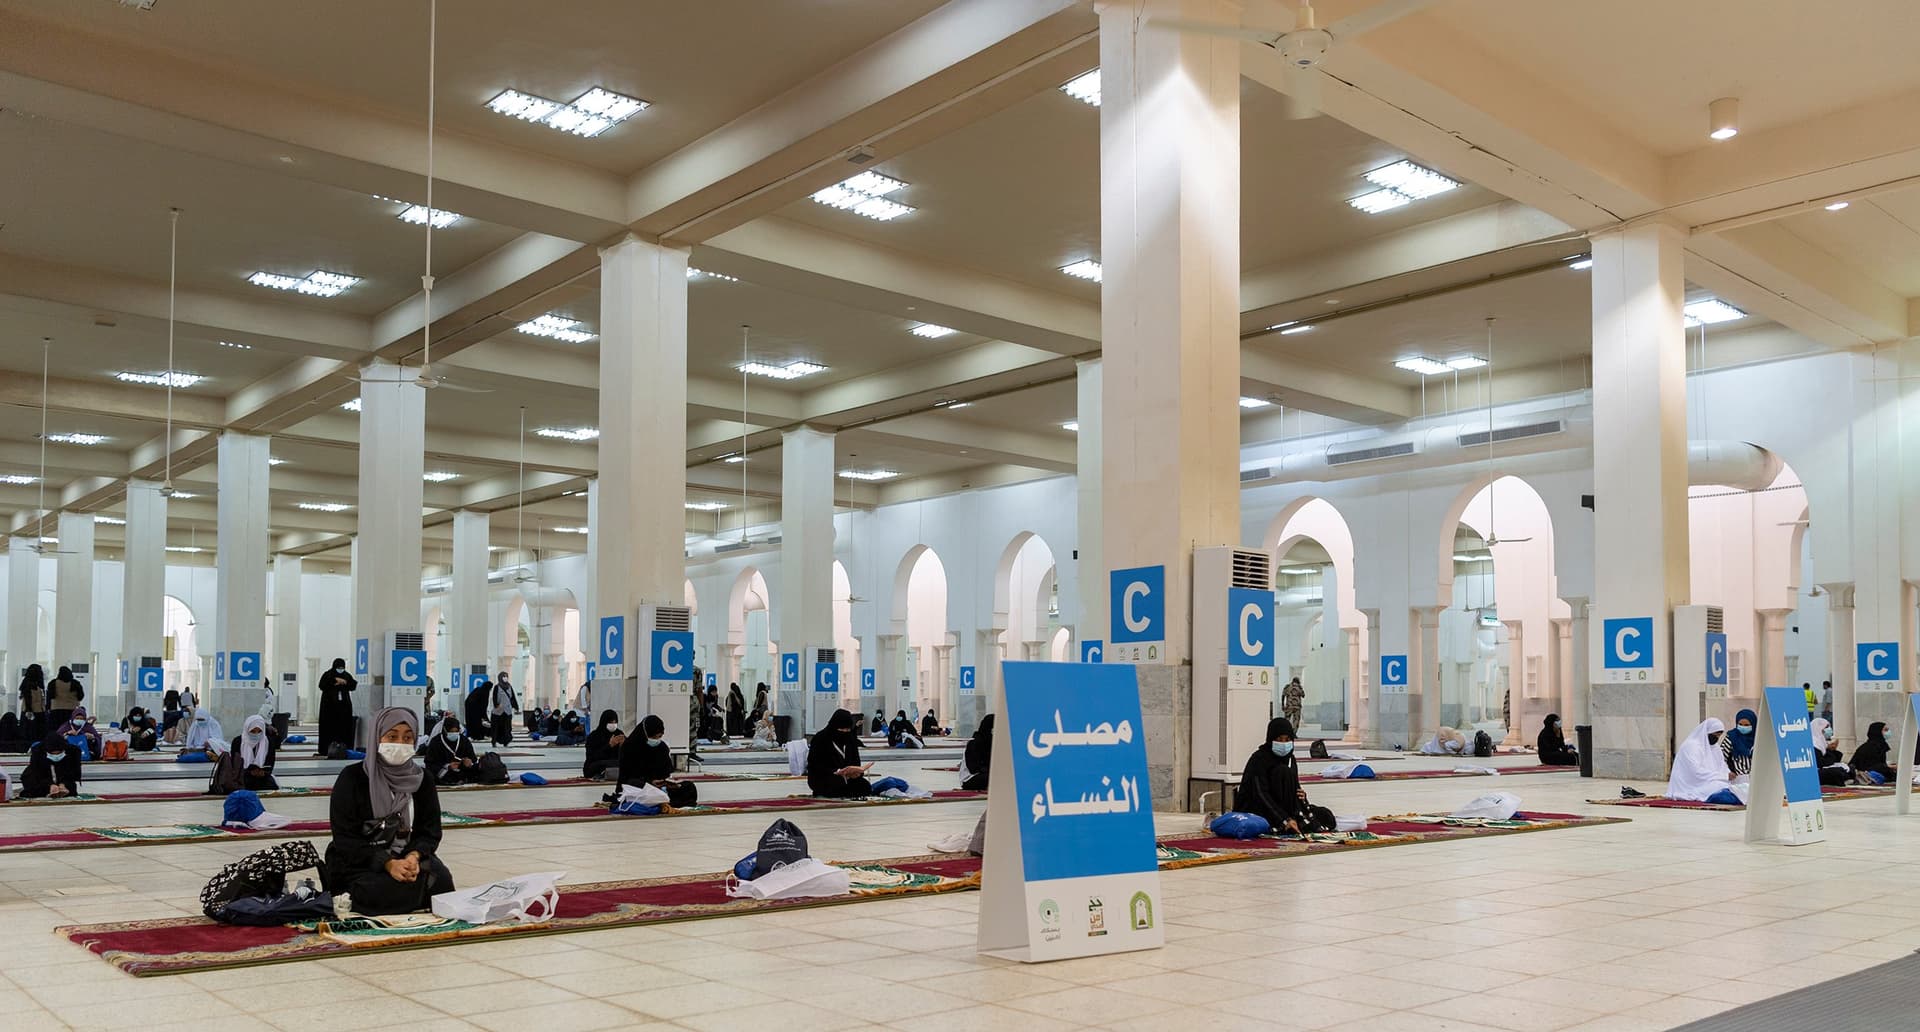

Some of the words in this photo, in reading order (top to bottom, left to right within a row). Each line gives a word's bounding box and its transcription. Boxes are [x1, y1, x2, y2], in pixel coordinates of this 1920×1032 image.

[1124, 581, 1151, 633] C
[605, 625, 618, 659] C
[1239, 602, 1264, 657] C
[358, 644, 366, 667] C
[661, 639, 683, 674] C
[1615, 627, 1641, 662] C
[237, 657, 252, 677] C
[400, 656, 418, 682] C
[786, 658, 794, 679] C
[1387, 660, 1401, 681] C
[1710, 641, 1723, 679] C
[1867, 649, 1889, 676] C
[144, 671, 157, 689] C
[820, 668, 833, 689] C
[864, 672, 872, 688] C
[963, 670, 971, 686] C
[1027, 709, 1133, 759] مصلى
[1778, 711, 1808, 739] مصلى
[1783, 747, 1814, 773] النساء
[1032, 775, 1140, 824] النساء
